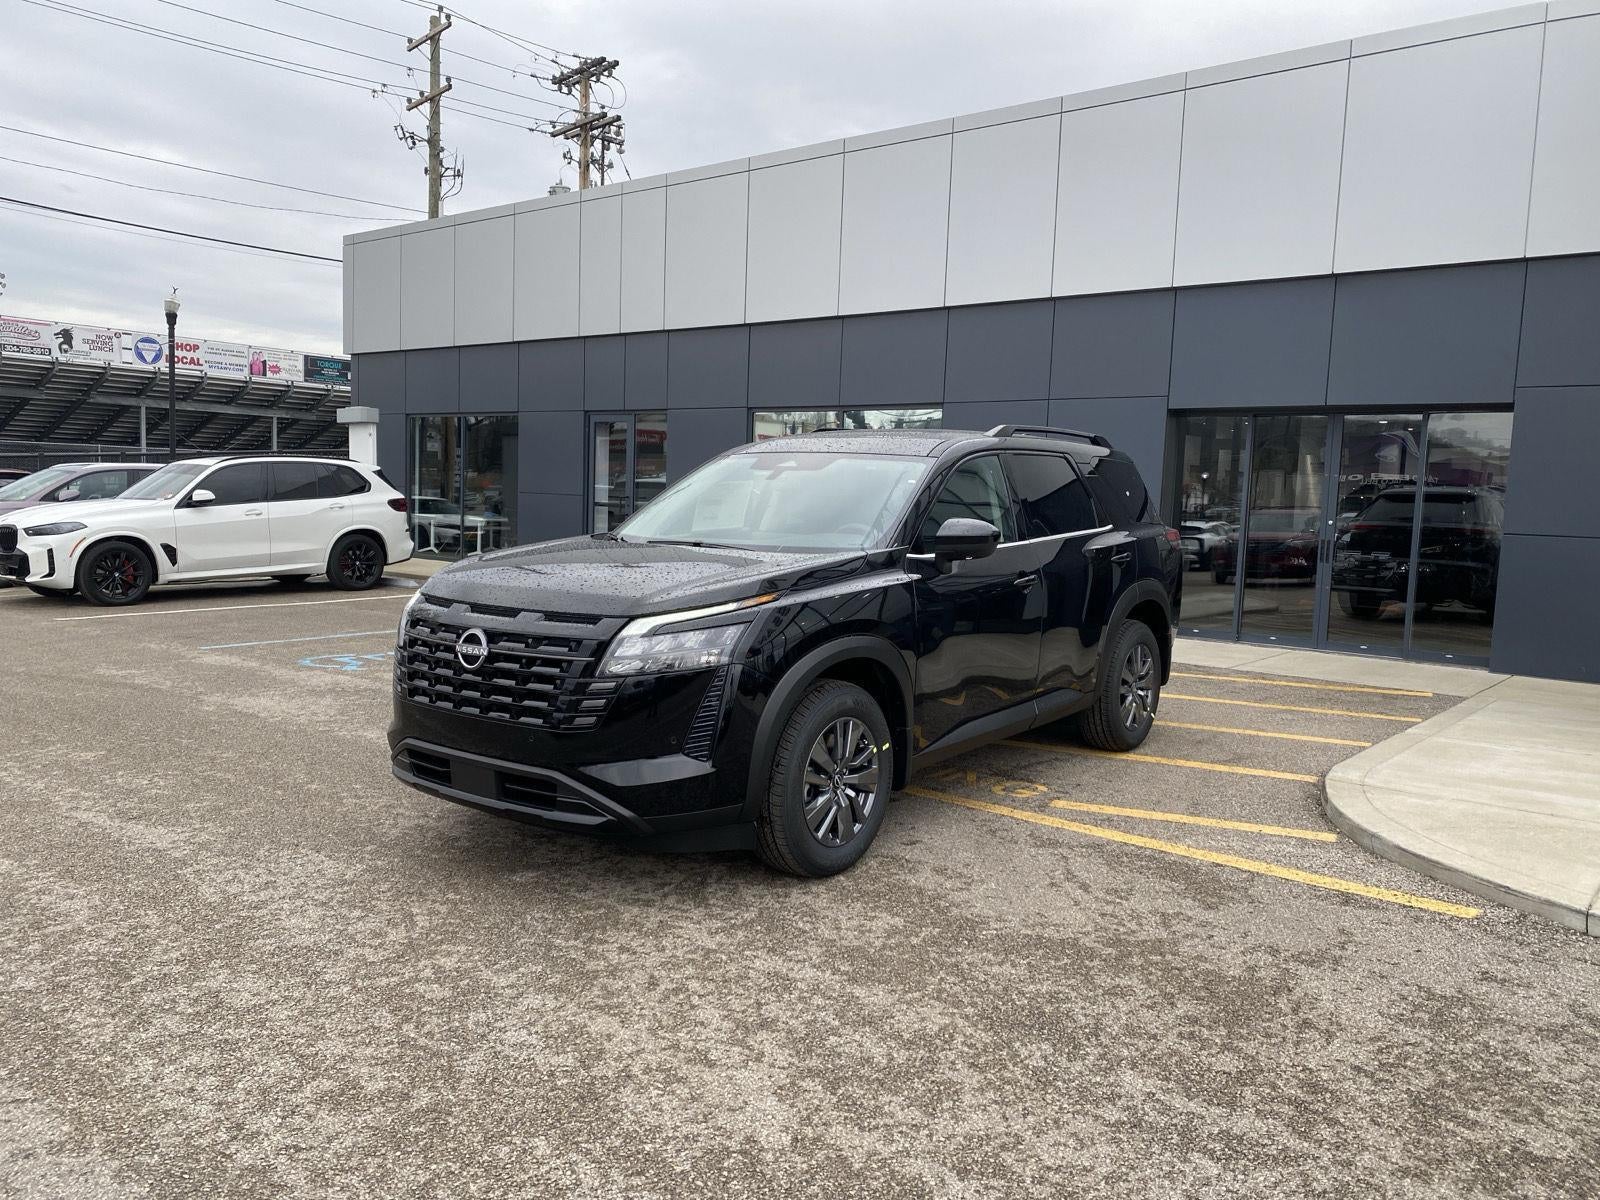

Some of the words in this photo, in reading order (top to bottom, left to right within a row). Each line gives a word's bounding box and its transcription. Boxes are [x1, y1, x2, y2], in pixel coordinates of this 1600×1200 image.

[81, 338, 114, 347] SERVING
[89, 344, 114, 353] LUNCH
[165, 353, 203, 366] LOCAL
[456, 645, 488, 656] NISSAN
